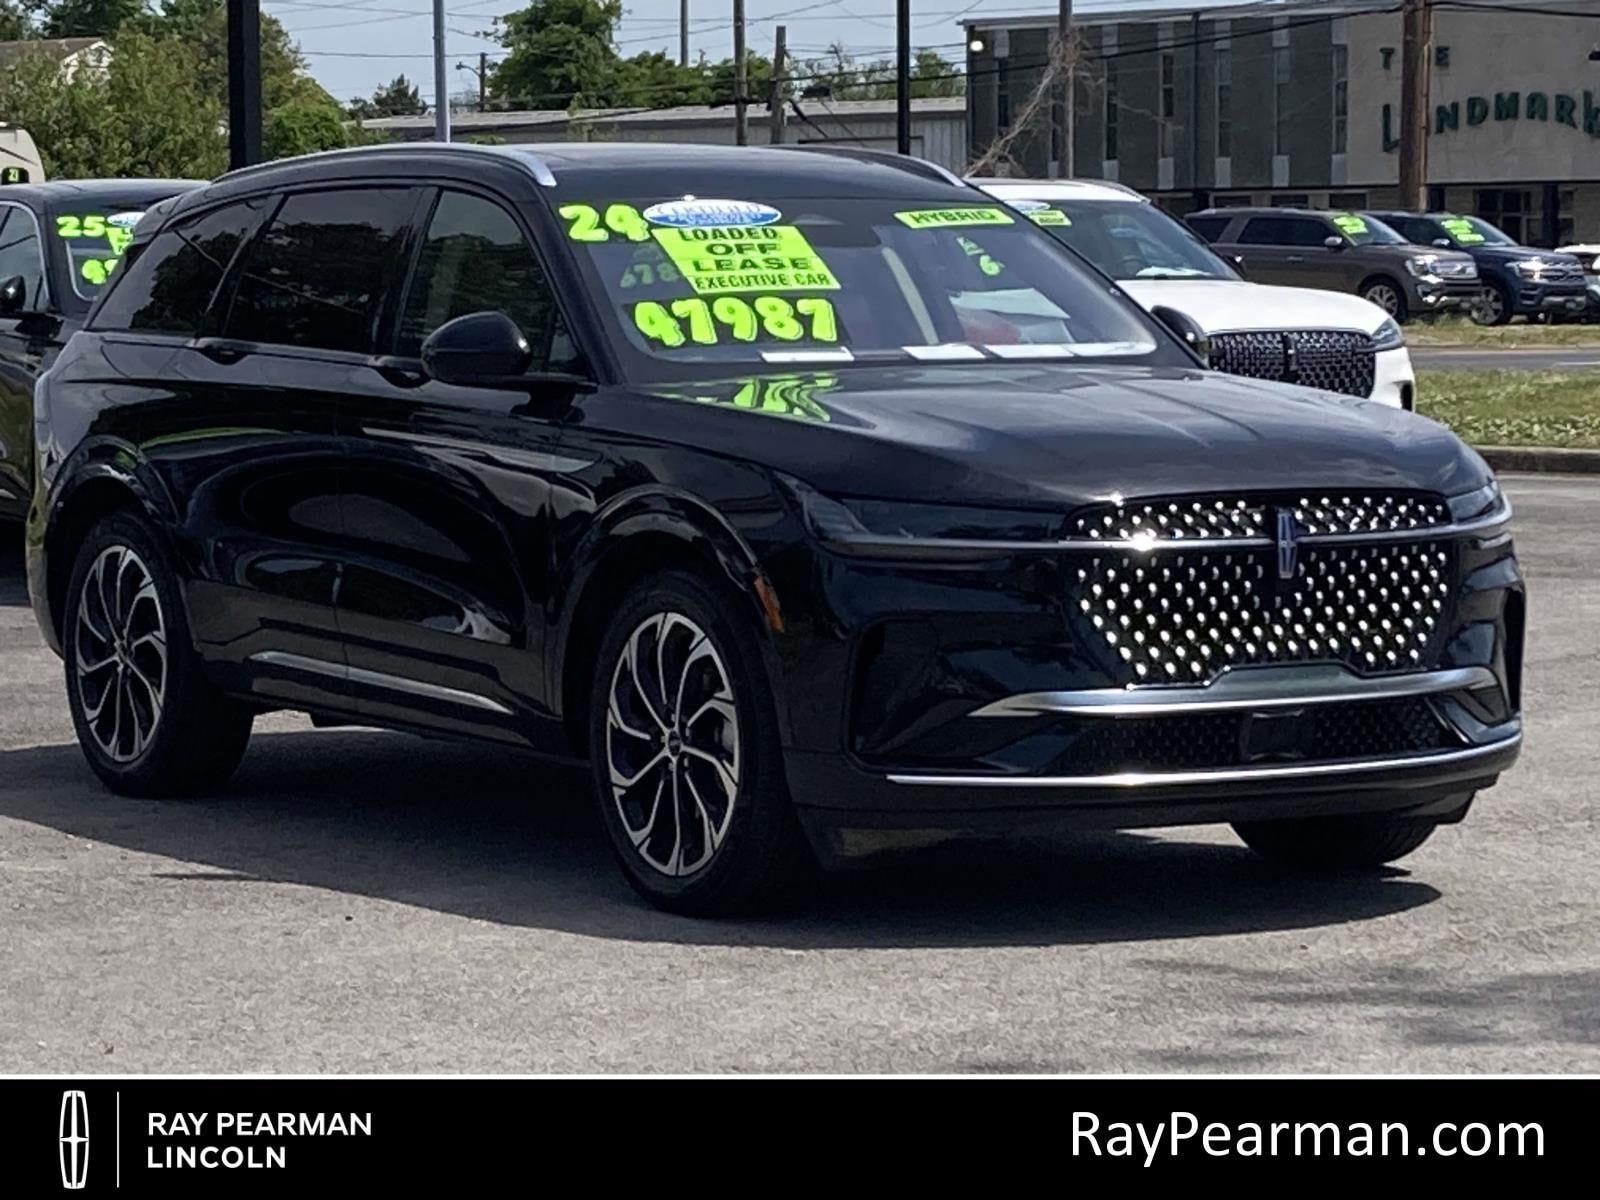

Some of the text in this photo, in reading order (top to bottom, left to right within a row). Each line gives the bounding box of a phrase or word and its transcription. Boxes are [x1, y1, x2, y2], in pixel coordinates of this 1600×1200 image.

[1380, 46, 1450, 70] TE
[1382, 90, 1600, 152] LNDMARK
[909, 210, 997, 224] HYBRID
[56, 216, 106, 237] 25
[678, 227, 779, 242] LOADED
[706, 243, 780, 256] OFF
[692, 257, 812, 272] LEASE
[695, 273, 831, 290] EXECUTIVE CAR
[635, 296, 838, 346] 47987
